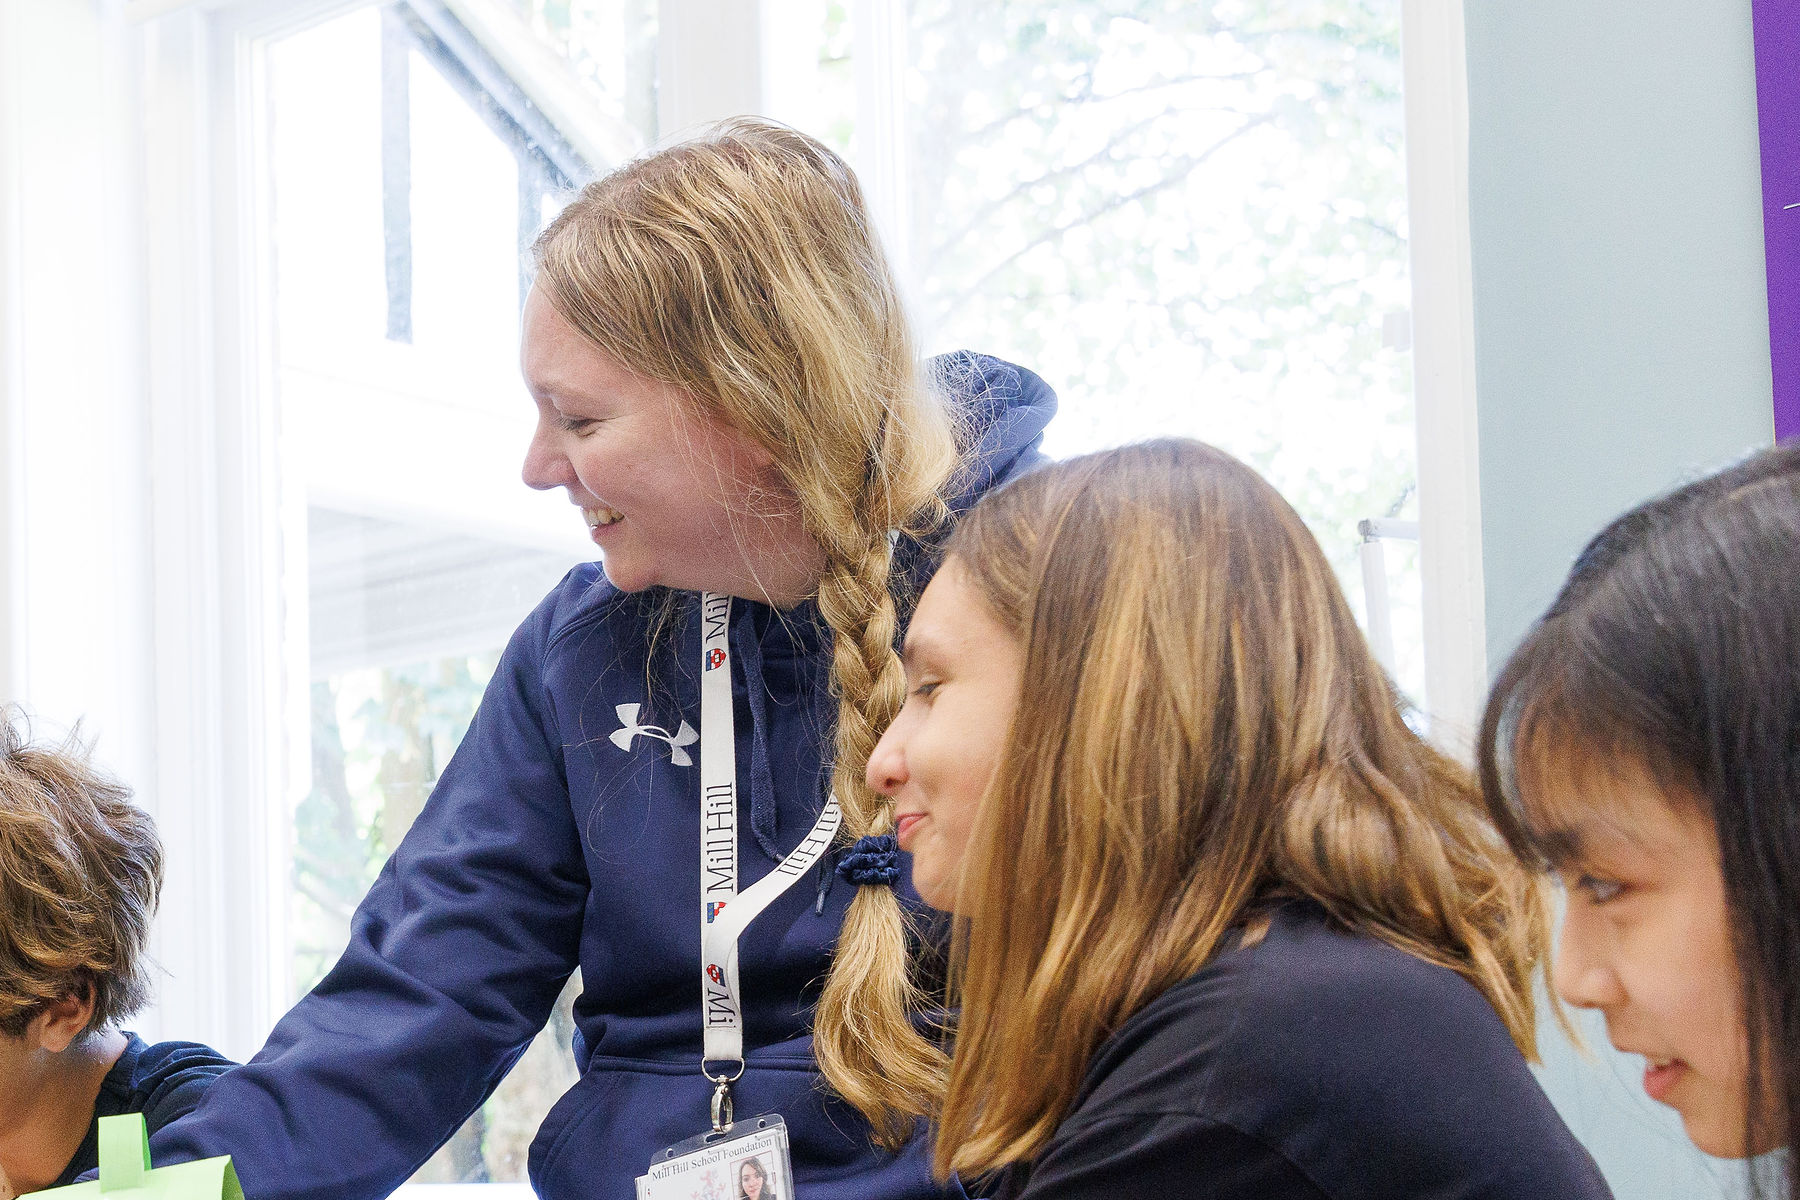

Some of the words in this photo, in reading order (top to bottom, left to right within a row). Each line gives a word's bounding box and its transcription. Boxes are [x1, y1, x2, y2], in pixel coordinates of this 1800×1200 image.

[706, 782, 733, 835] Hill
[815, 801, 840, 832] ill
[706, 838, 733, 894] Mill
[776, 837, 827, 876] Hill
[652, 1165, 670, 1182] Mill
[672, 1162, 689, 1175] Hill
[691, 1151, 721, 1169] School
[723, 1137, 772, 1161] Foundation
